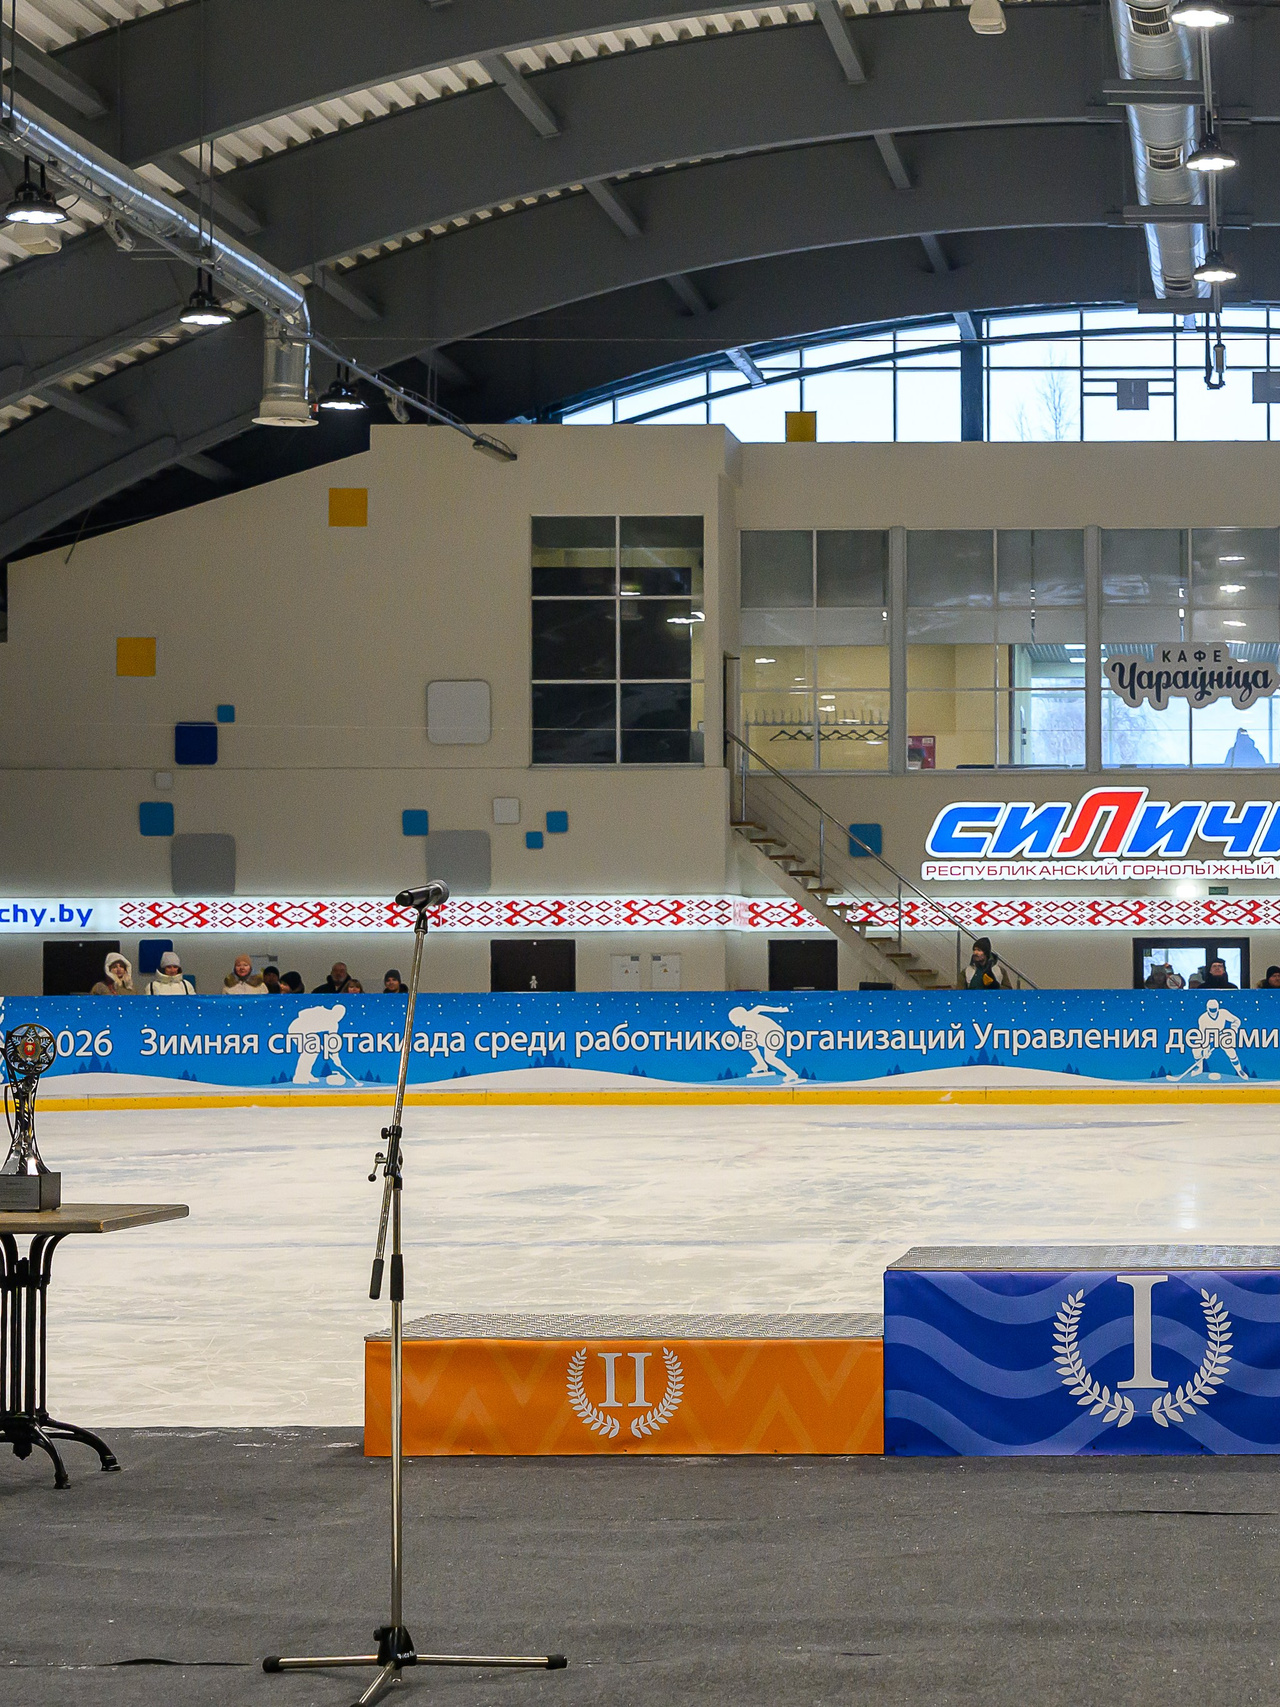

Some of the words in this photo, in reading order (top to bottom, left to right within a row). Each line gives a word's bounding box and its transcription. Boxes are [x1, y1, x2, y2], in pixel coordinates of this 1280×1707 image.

[1161, 650, 1222, 663] КАФЕ
[926, 861, 1121, 876] РЕСПУБЛИКАНСКИЙ
[1123, 861, 1274, 876] ГОРНОЛЫЖНЫЙ
[56, 1029, 114, 1057] 026
[140, 1027, 259, 1056] Зимняя
[474, 1030, 567, 1059] среди
[575, 1022, 758, 1059] работников
[764, 1024, 965, 1058] организаций
[973, 1023, 1158, 1056] Управления
[1165, 1027, 1279, 1053] делами
[597, 1352, 653, 1408] II
